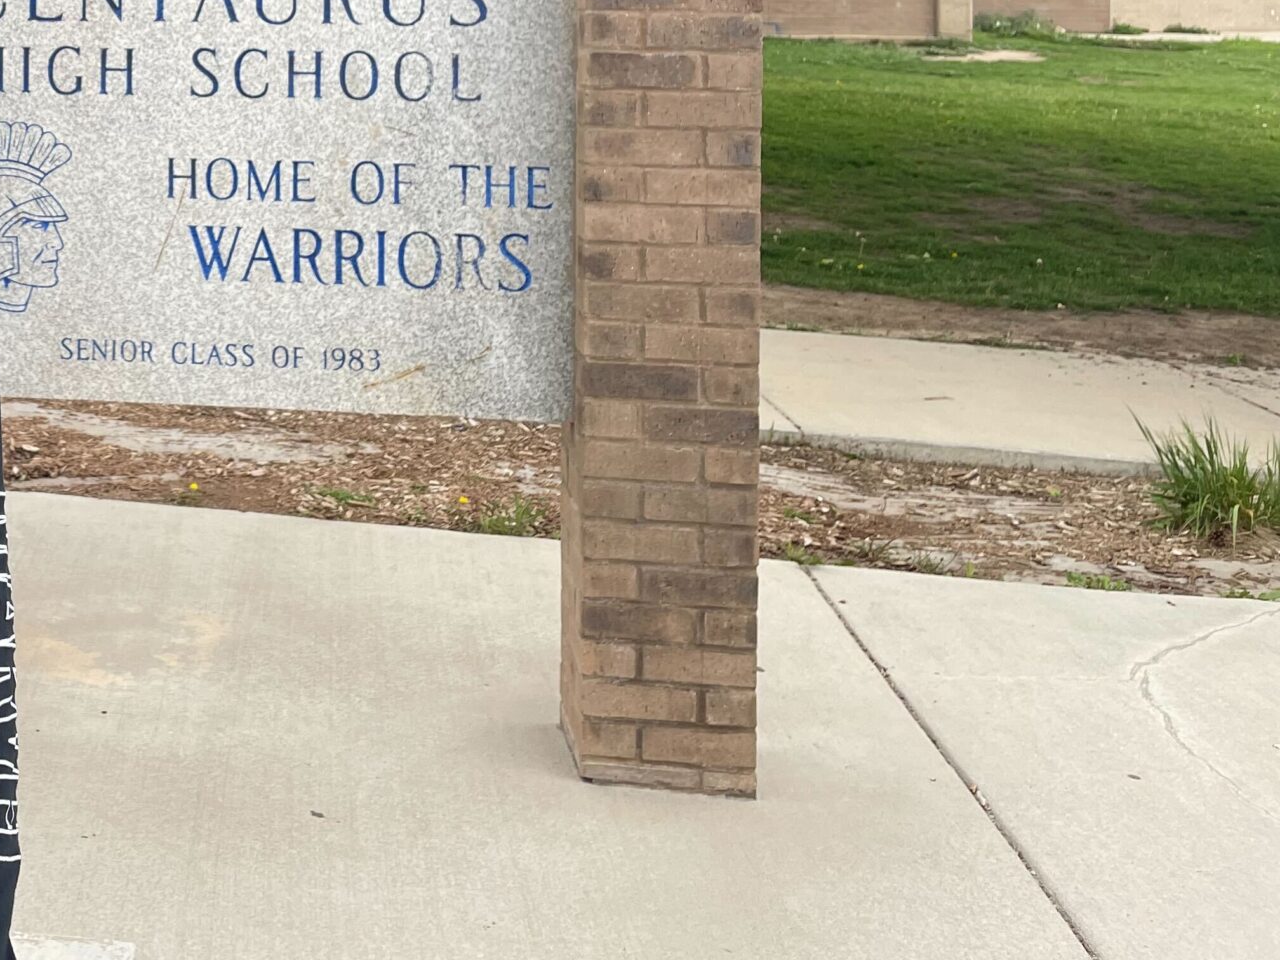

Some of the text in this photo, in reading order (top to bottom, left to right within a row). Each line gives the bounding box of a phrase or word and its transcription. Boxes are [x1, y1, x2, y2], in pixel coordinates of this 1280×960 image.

[190, 48, 482, 101] SCHOOL
[167, 157, 554, 209] HOME OF THE
[189, 225, 533, 292] WARRIORS
[60, 338, 381, 371] SENIOR CLASS OF 1983
